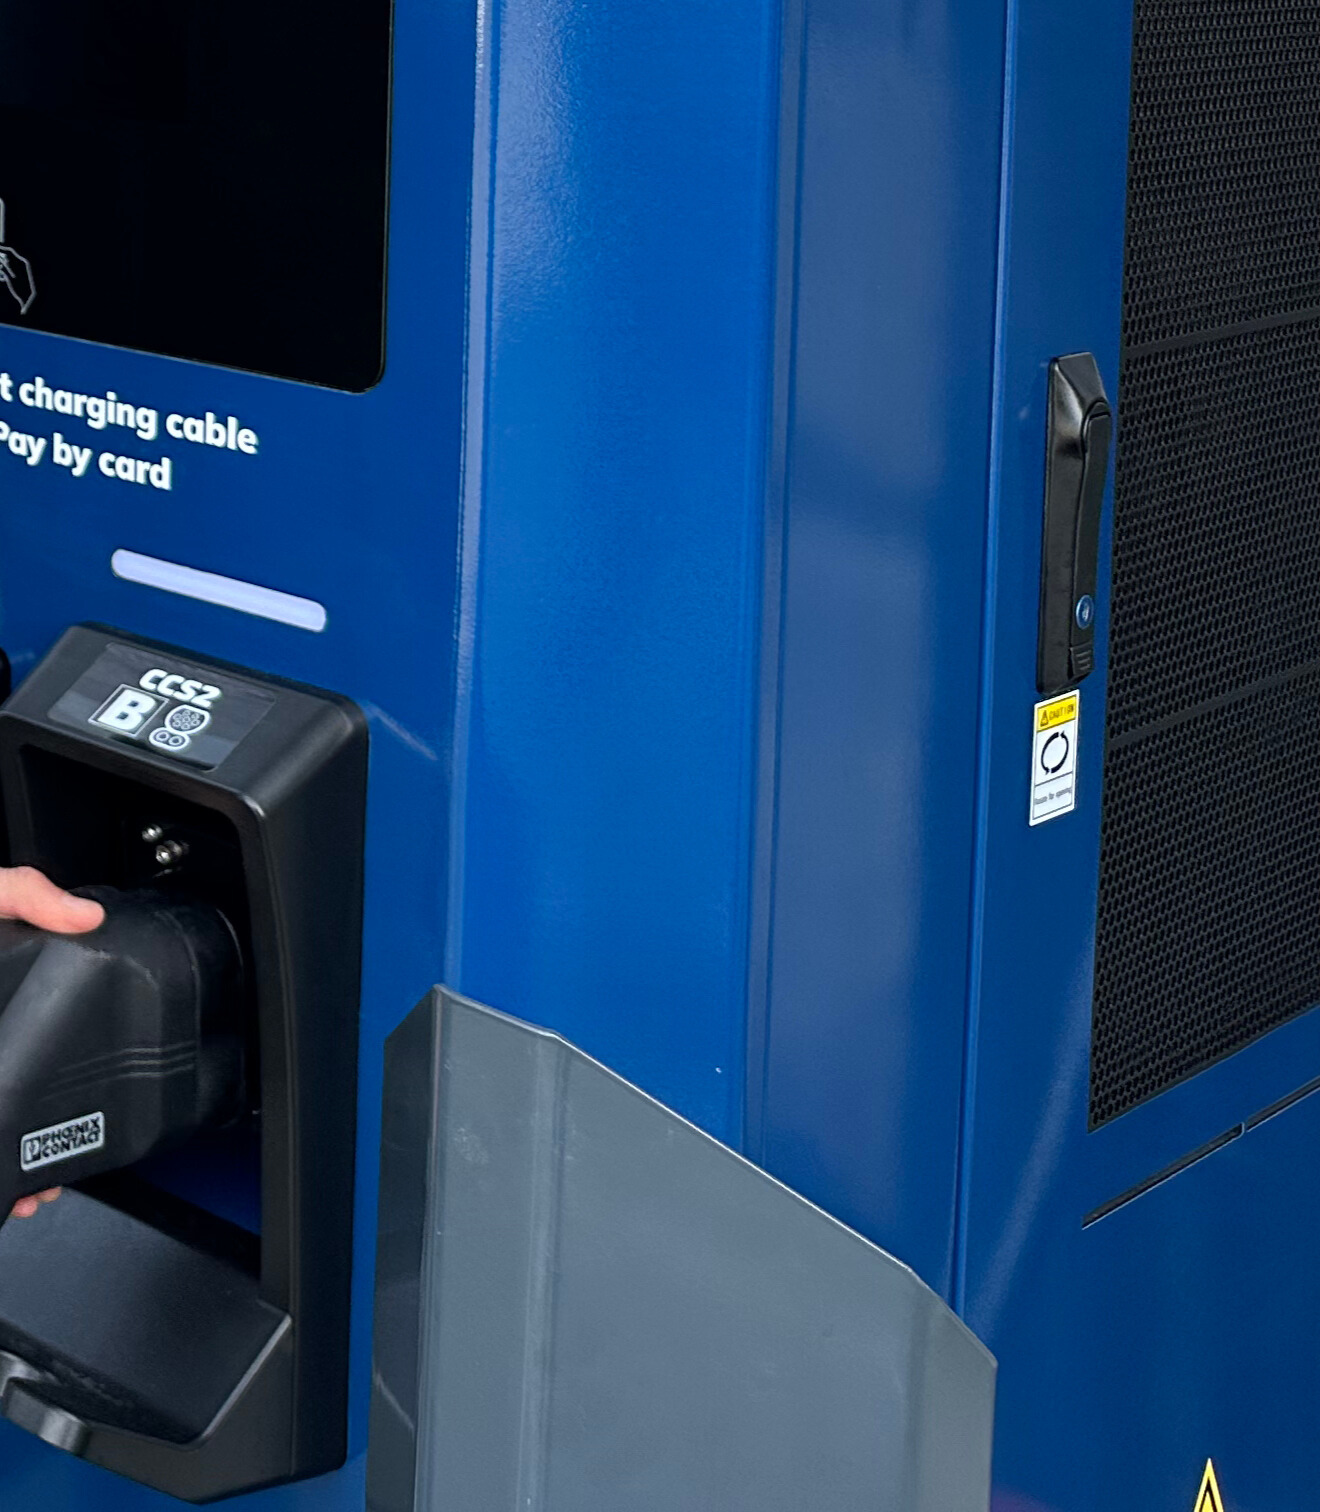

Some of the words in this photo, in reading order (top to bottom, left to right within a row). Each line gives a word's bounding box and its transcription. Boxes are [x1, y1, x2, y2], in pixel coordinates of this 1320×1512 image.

[18, 376, 158, 441] charging
[165, 411, 258, 455] cable
[52, 432, 93, 477] by
[98, 452, 171, 491] card
[139, 668, 222, 709] CCS2
[97, 689, 157, 731] B
[1049, 704, 1074, 720] CAUTION
[42, 1129, 100, 1158] CONTACT
